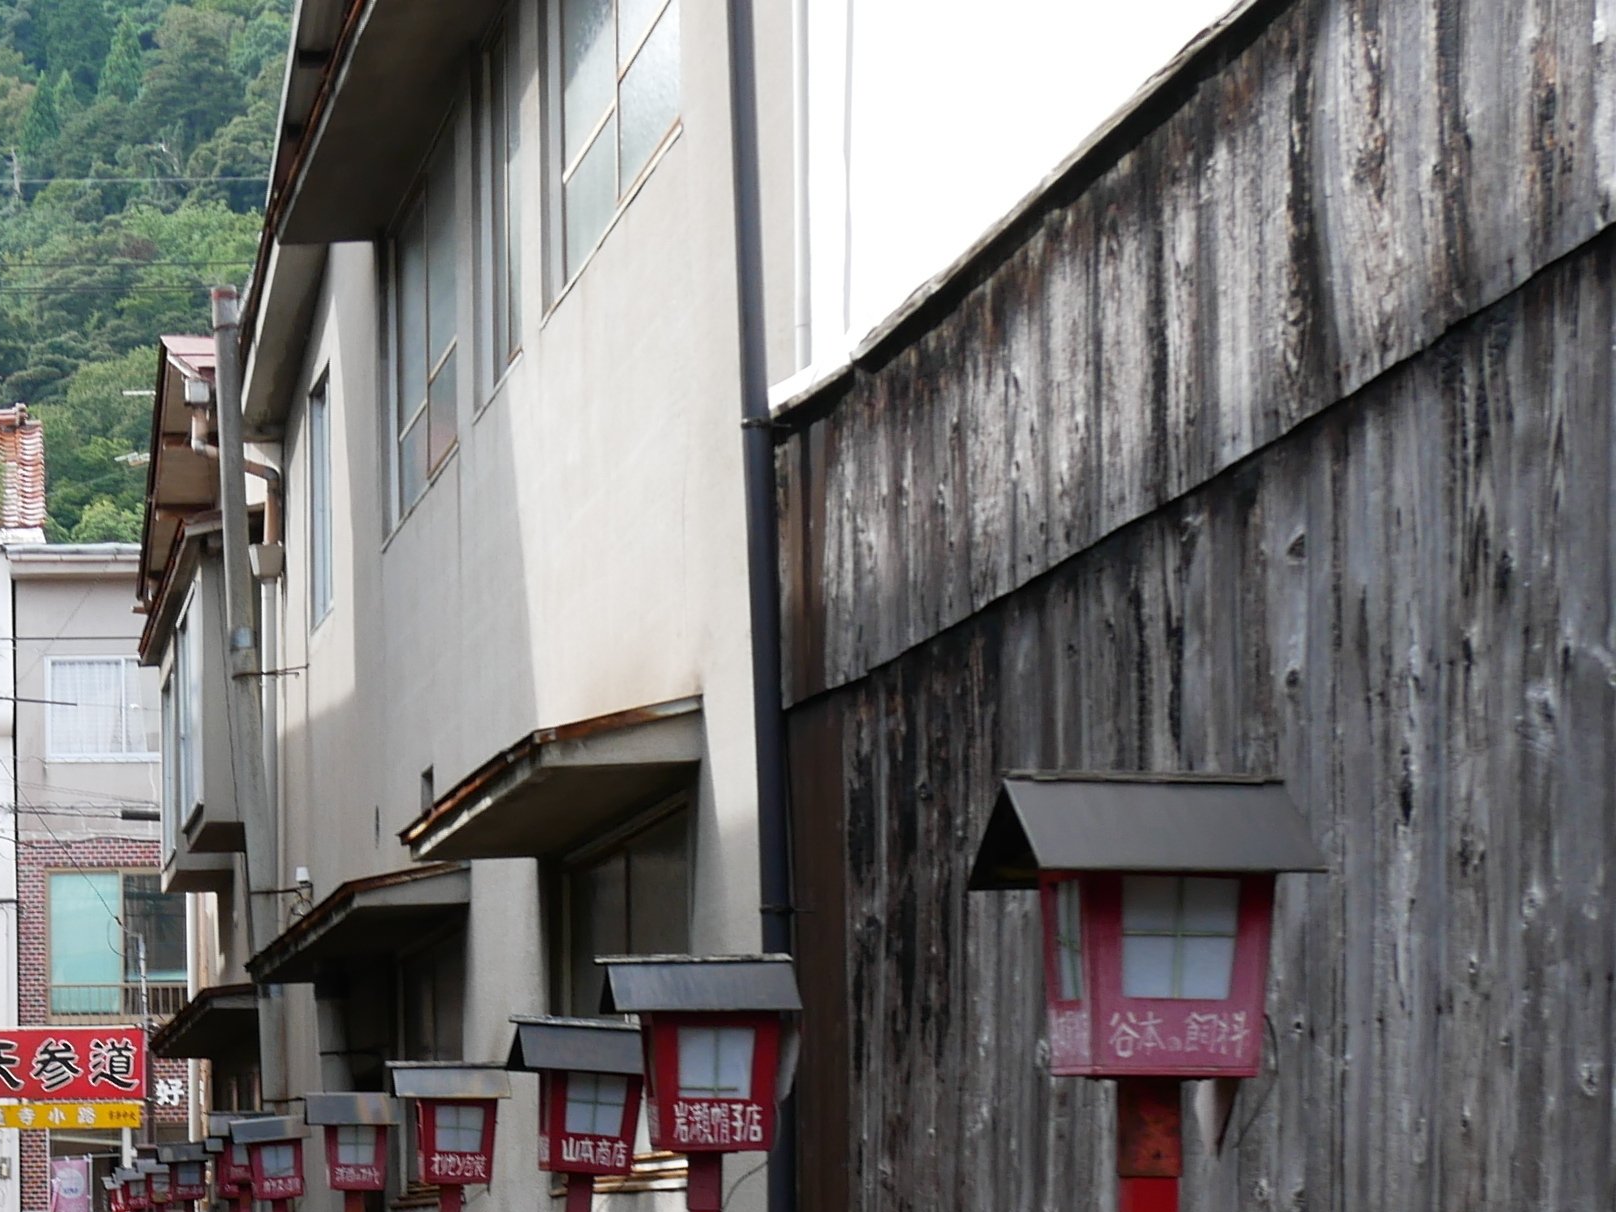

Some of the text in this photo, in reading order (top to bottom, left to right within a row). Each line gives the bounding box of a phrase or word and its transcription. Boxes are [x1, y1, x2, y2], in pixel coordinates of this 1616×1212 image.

[1108, 1010, 1251, 1058] 谷本の飼料
[672, 1101, 763, 1144] 岩瀬帽子店
[561, 1136, 628, 1168] 山本商店
